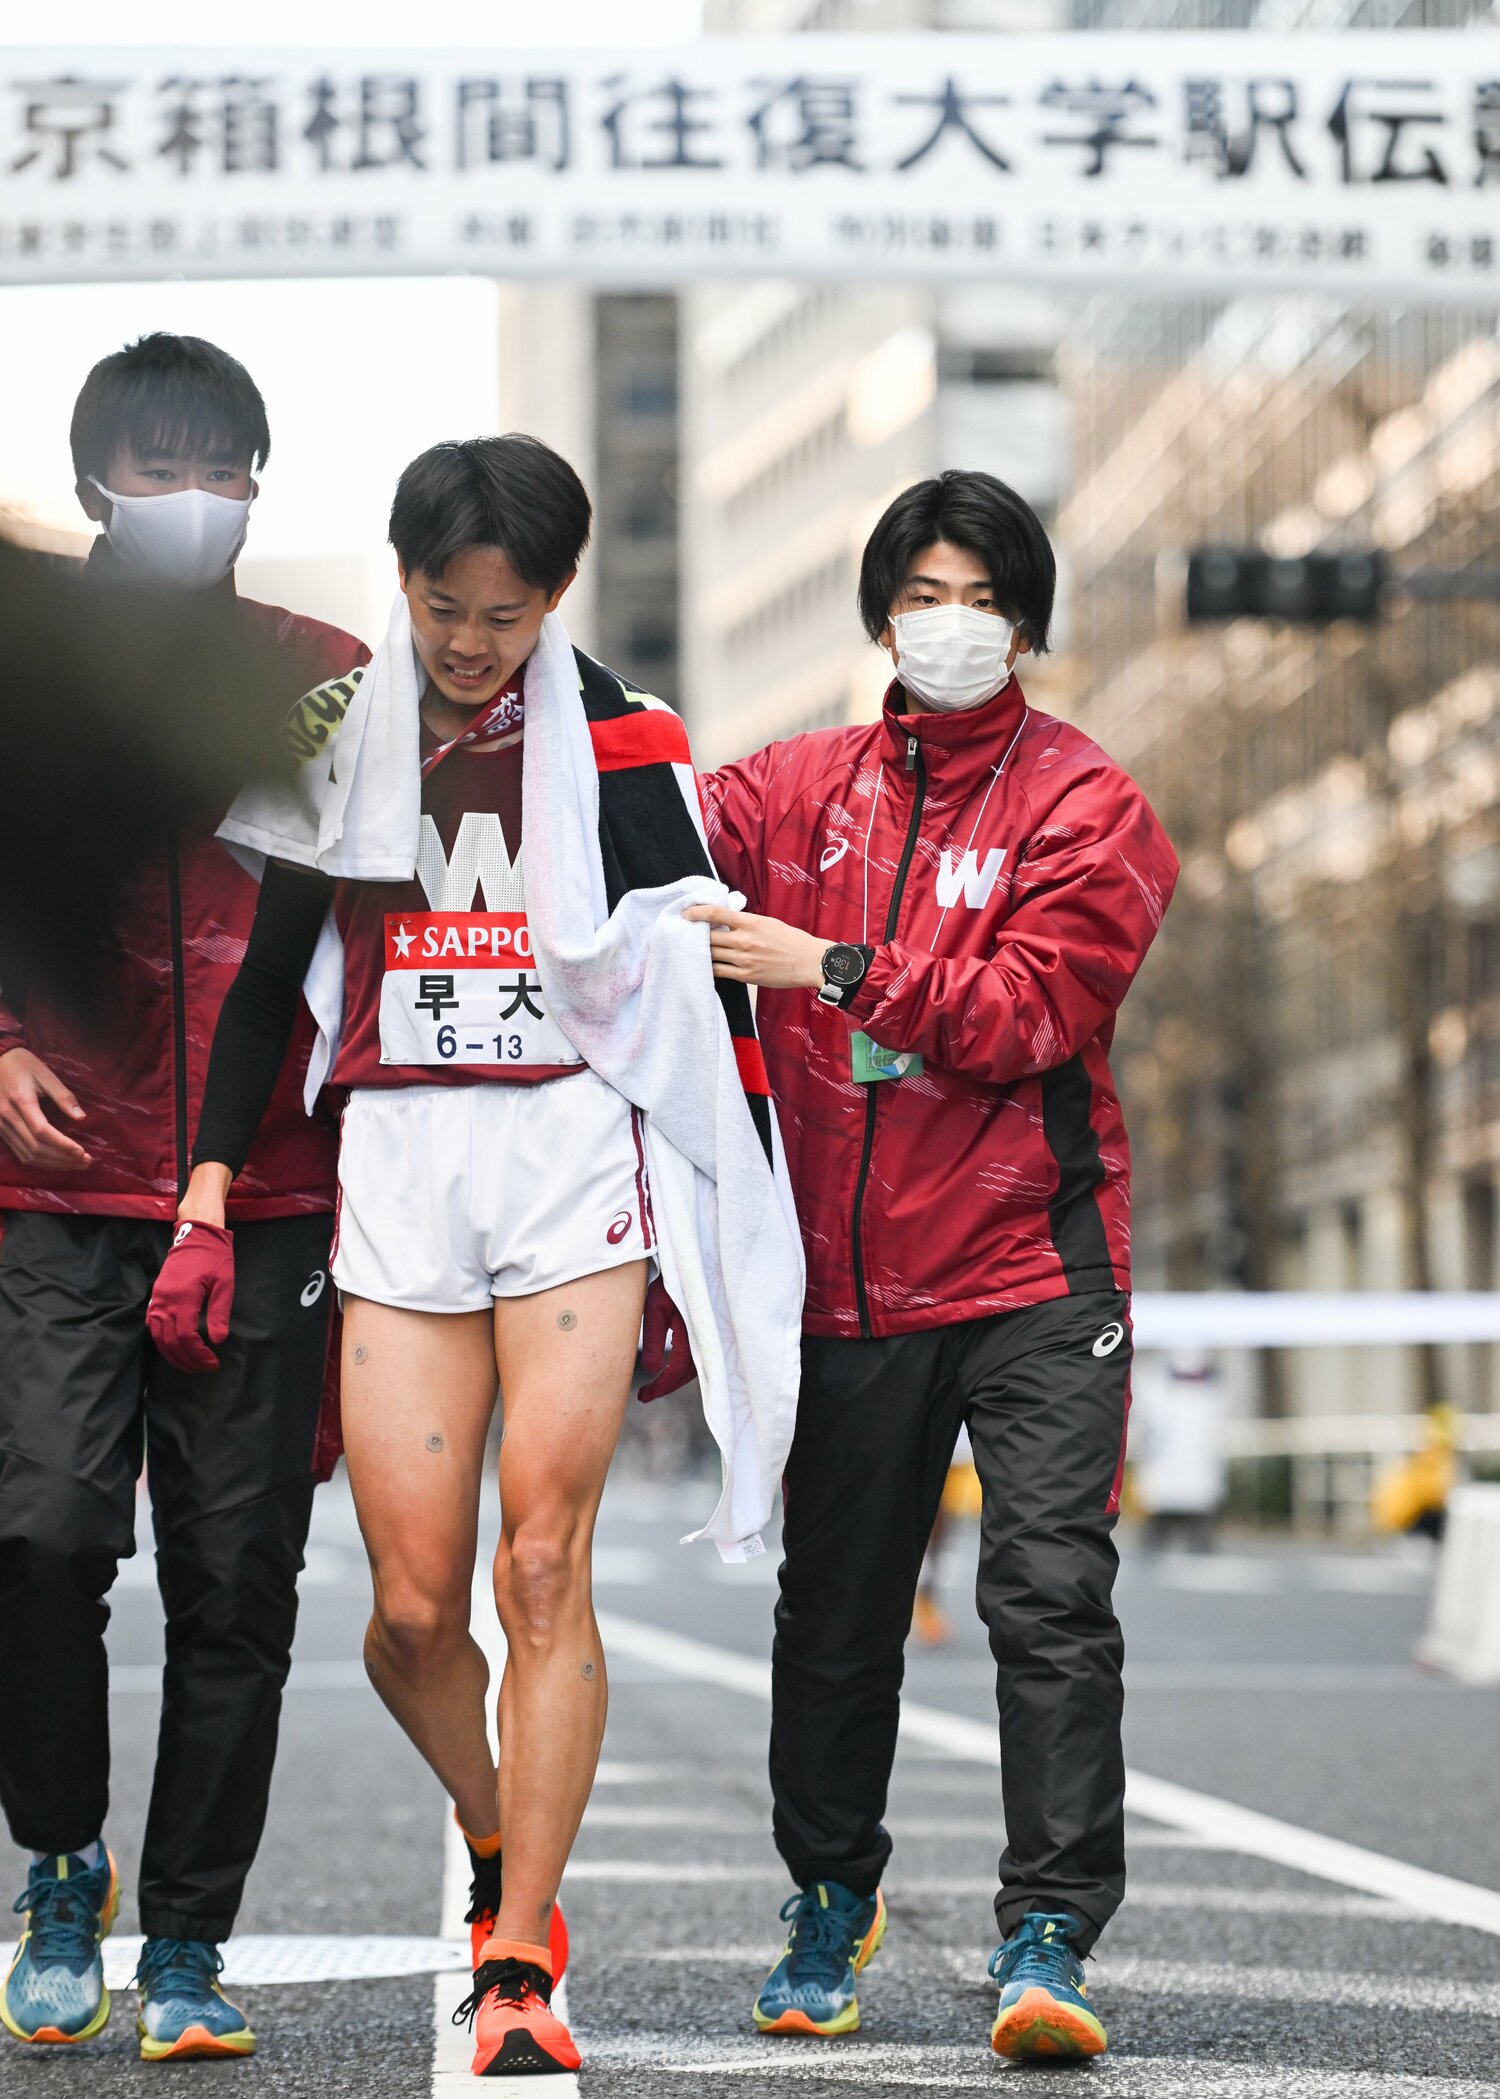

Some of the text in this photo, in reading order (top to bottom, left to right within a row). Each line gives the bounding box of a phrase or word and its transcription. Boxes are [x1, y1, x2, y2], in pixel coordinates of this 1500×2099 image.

[10, 72, 1500, 185] 京箱根間往復大学駅伝
[936, 848, 1008, 909] W
[421, 926, 535, 958] SAPPO
